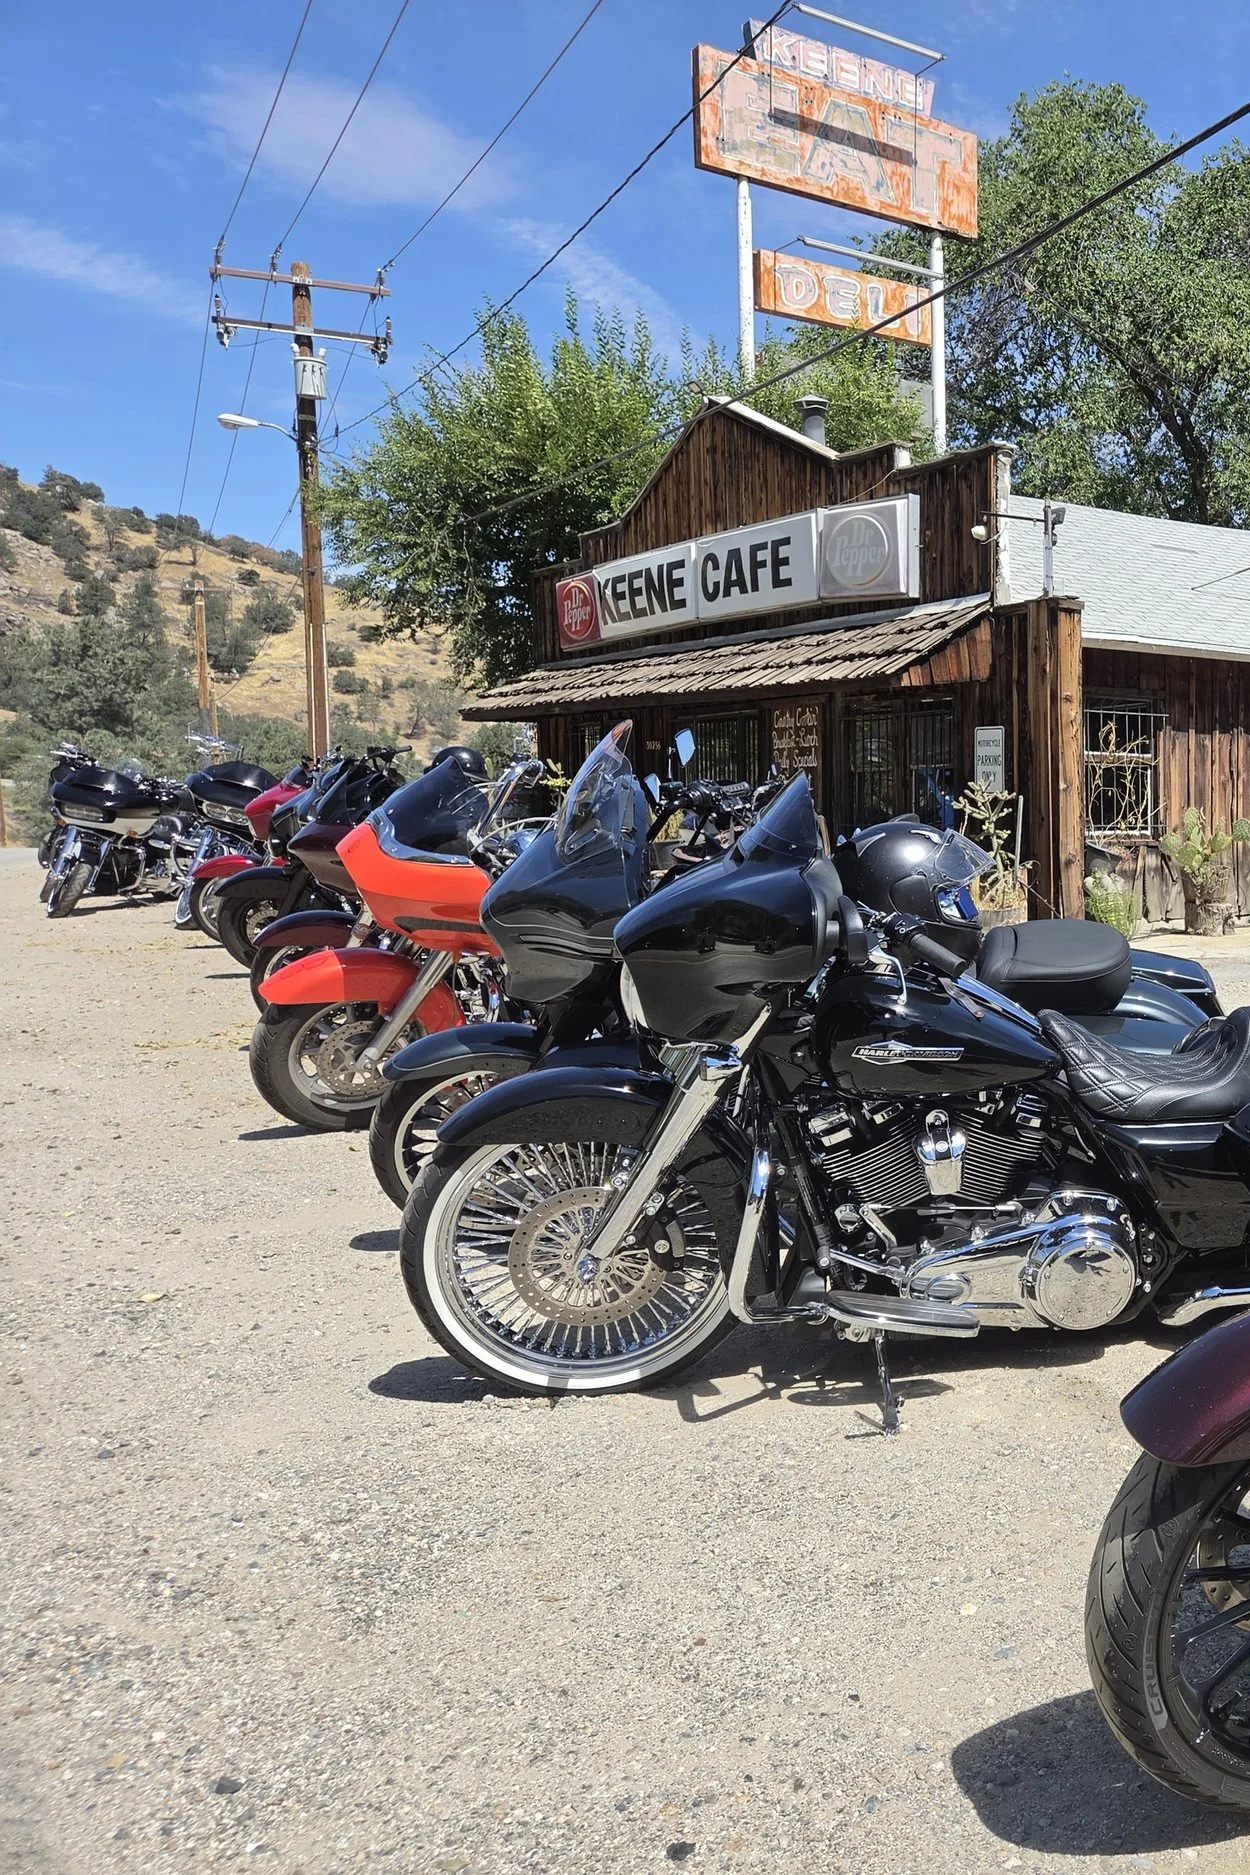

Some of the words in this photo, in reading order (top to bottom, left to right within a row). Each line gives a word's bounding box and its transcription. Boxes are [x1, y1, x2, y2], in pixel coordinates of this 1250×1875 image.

[763, 31, 925, 110] KEENE
[719, 63, 963, 215] EAT
[774, 264, 922, 337] DELI
[850, 520, 875, 545] Dr
[832, 536, 884, 577] Pepper
[571, 587, 584, 608] Dr
[598, 559, 687, 626] KEENE
[701, 536, 793, 603] CAFE
[563, 599, 591, 632] Pepper
[977, 740, 1001, 748] MOTORCYCLE
[977, 754, 1001, 766] PARKING
